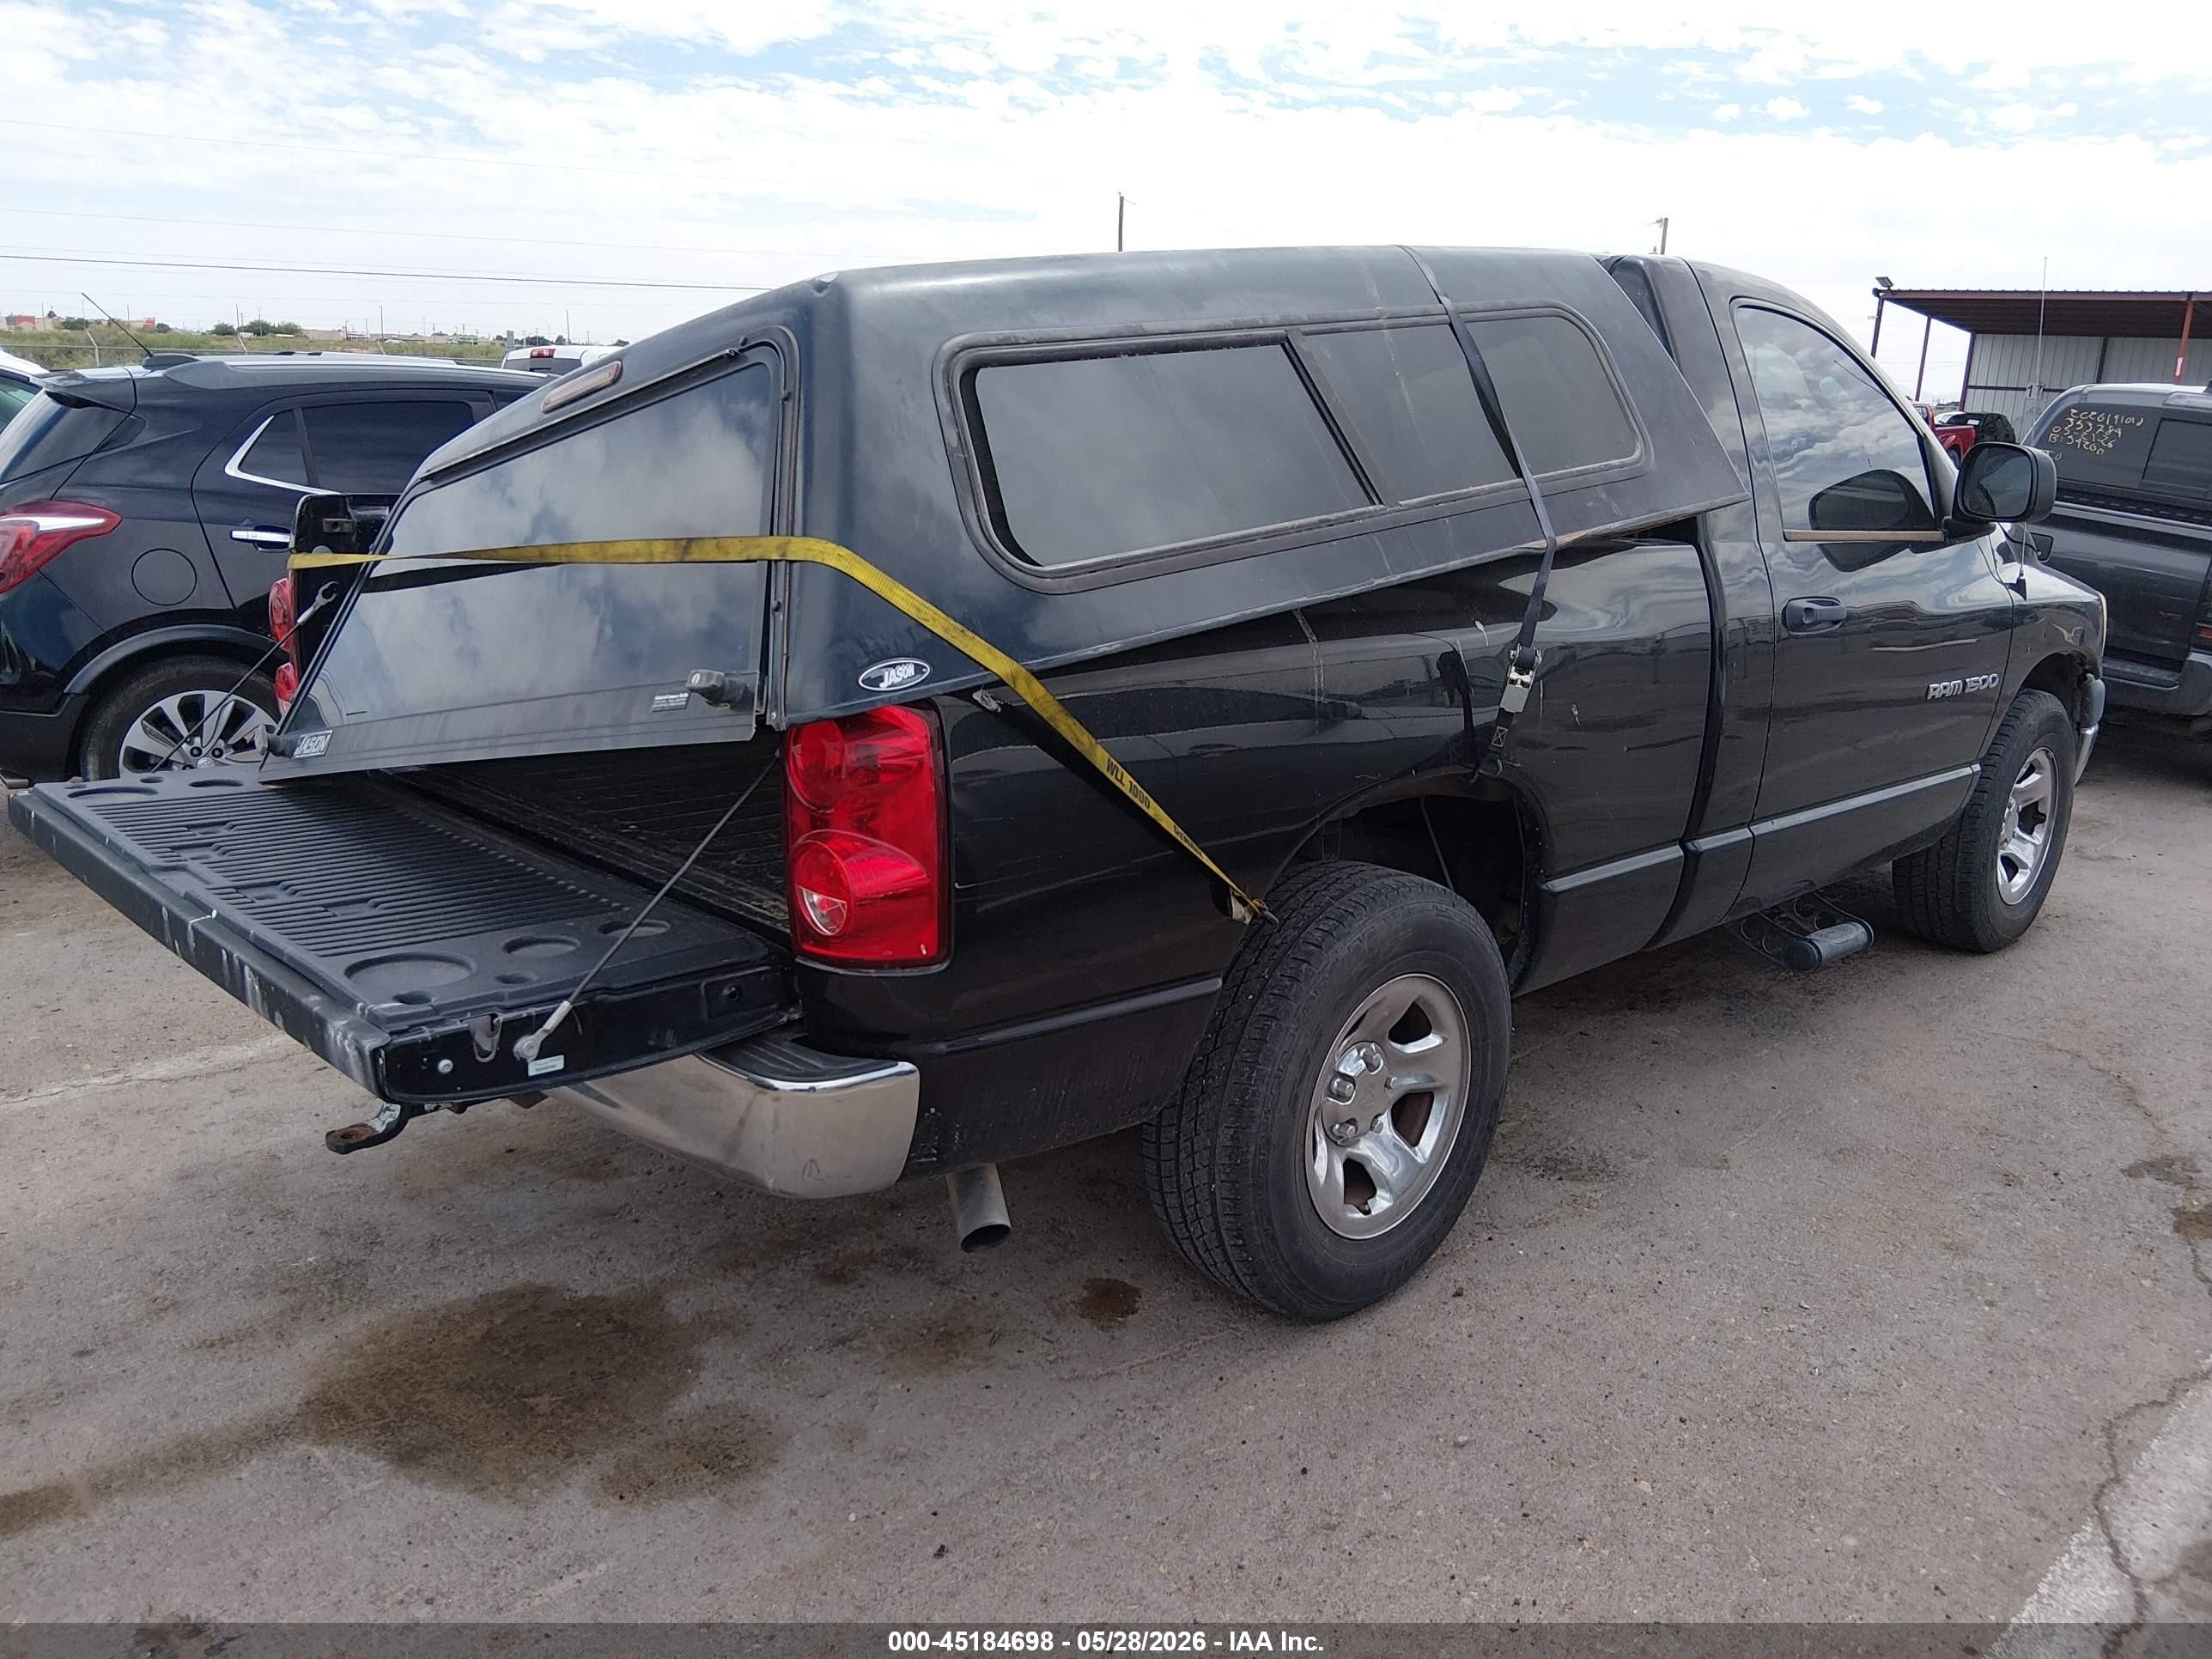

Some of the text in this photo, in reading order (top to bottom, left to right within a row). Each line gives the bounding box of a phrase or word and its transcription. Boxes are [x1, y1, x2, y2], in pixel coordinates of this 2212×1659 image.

[879, 663, 915, 689] JASON
[1926, 673, 1999, 700] RAM 1500
[295, 734, 328, 756] JASON
[1106, 757, 1151, 810] WLL 1000
